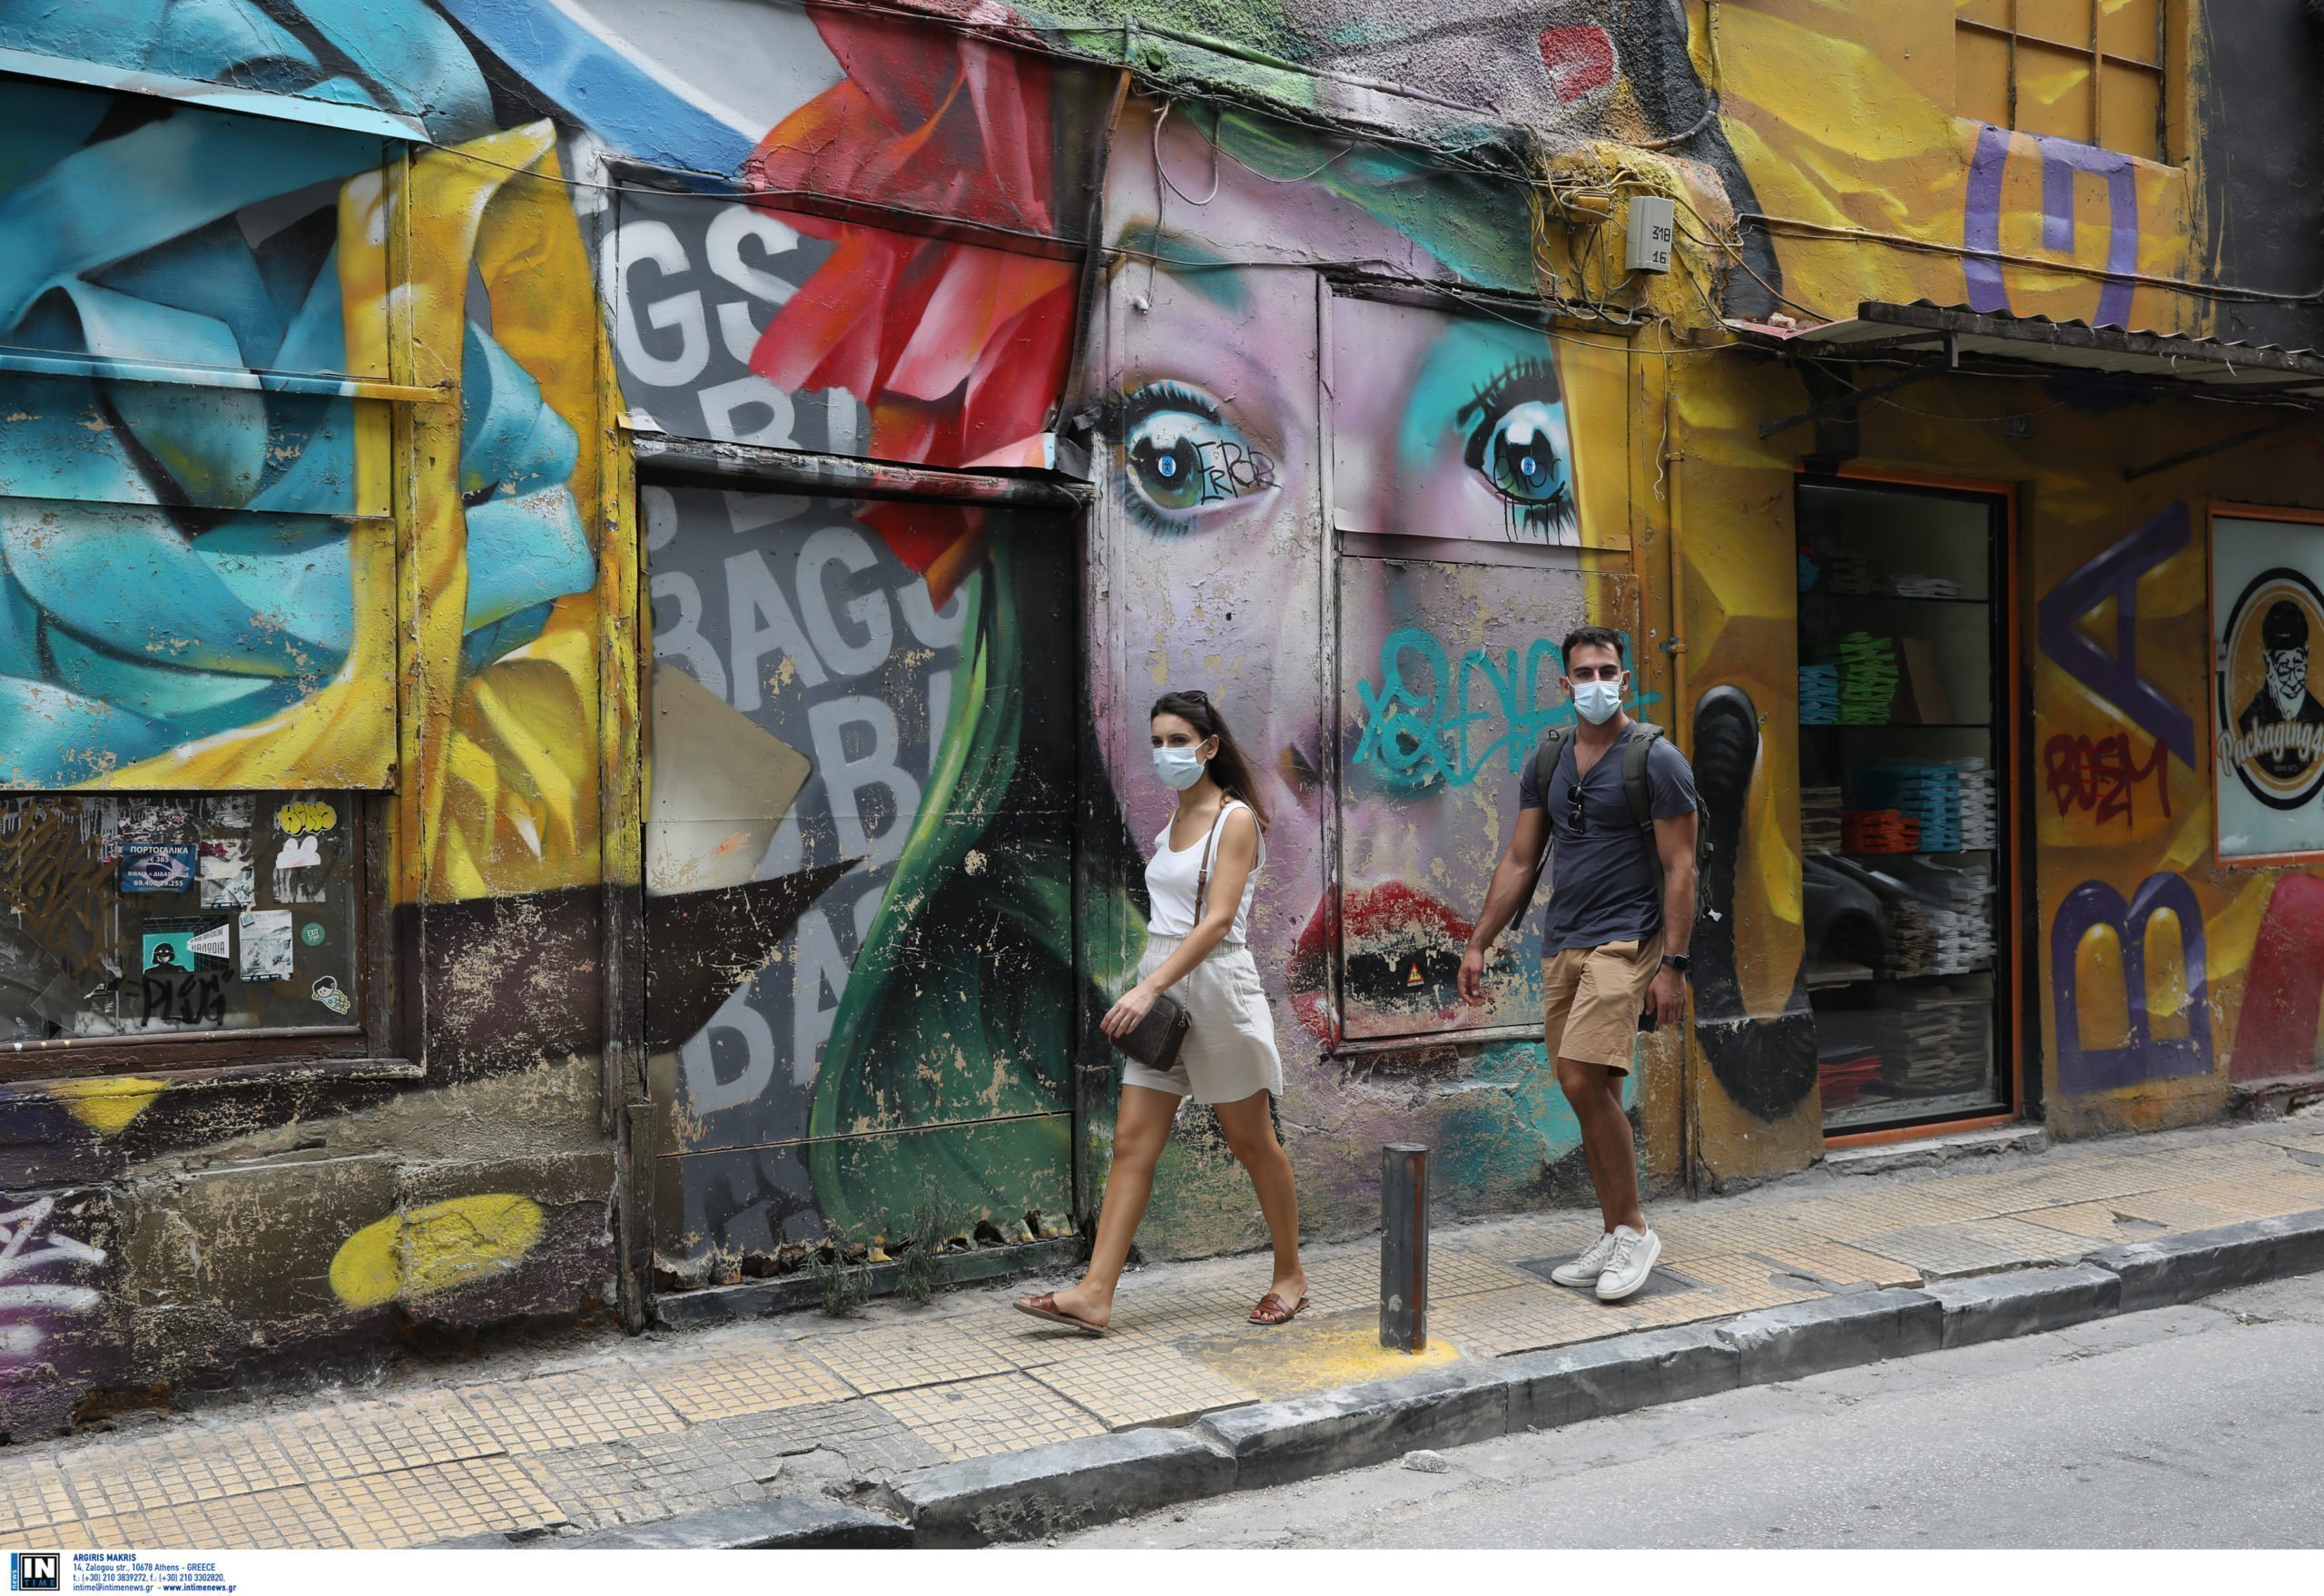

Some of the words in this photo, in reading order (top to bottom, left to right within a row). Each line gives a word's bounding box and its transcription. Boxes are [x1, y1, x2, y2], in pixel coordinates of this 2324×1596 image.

[1652, 250, 1669, 264] 16
[2217, 710, 2324, 777] Packaging4
[130, 845, 189, 854] ΠΟΡΤΟΓΑΛΙΚΑ
